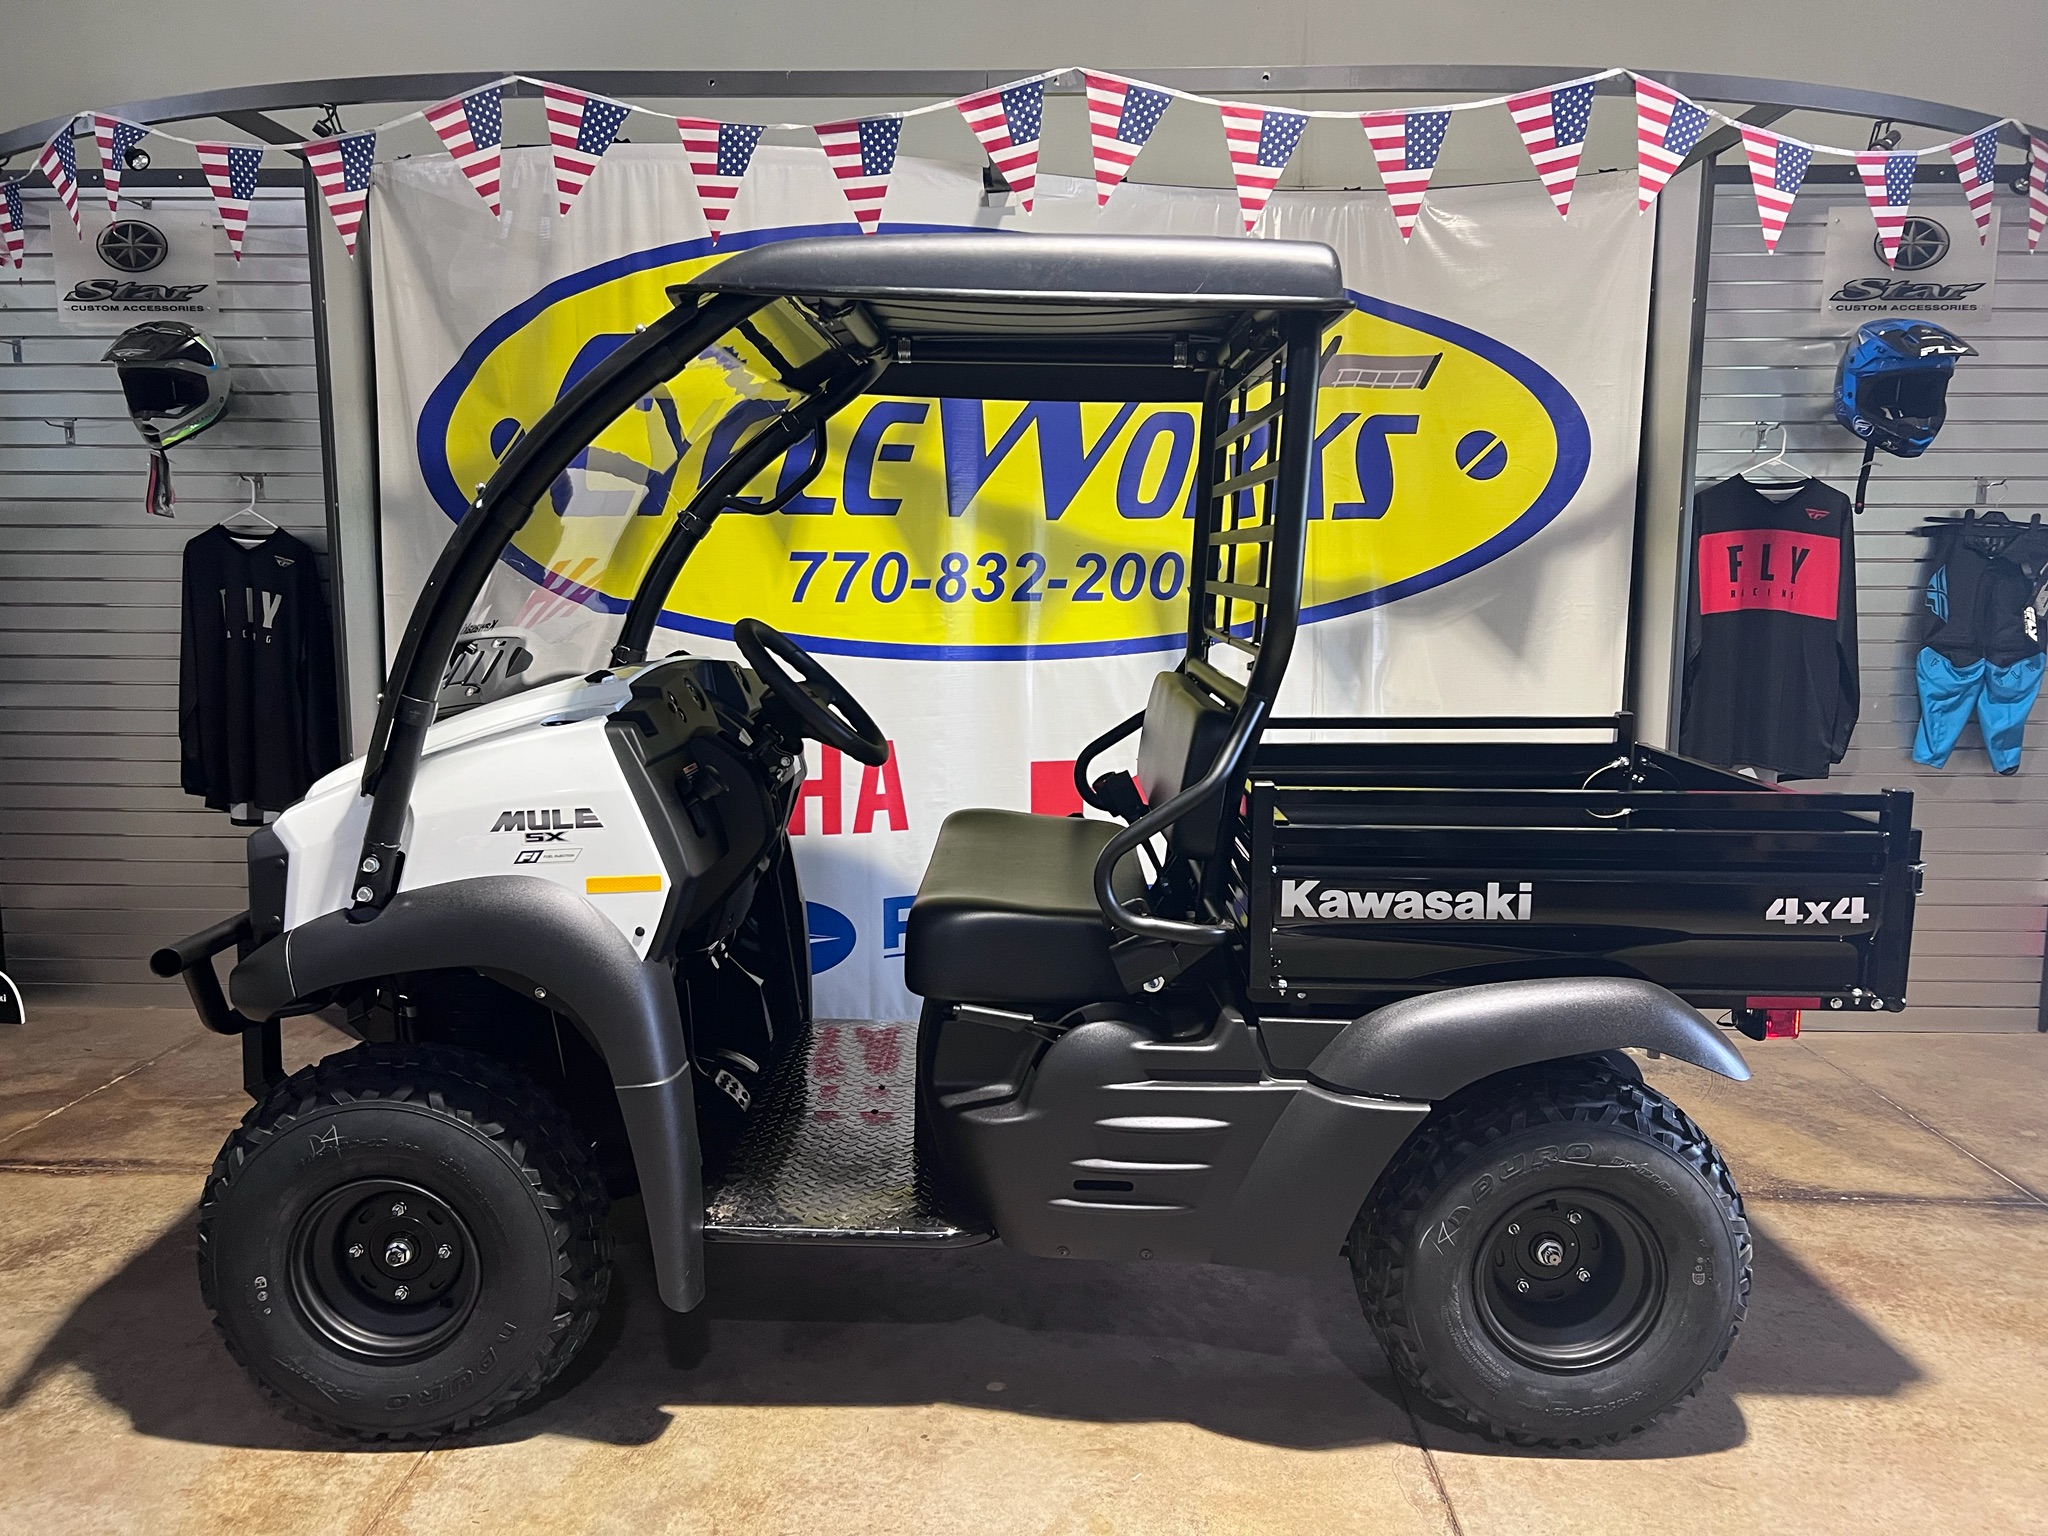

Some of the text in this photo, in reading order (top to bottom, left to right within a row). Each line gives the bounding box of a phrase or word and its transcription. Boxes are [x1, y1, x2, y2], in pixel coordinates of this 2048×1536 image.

[63, 278, 209, 302] Star
[1829, 277, 1987, 301] Star
[1835, 304, 1888, 312] CUSTOM
[1920, 345, 1969, 358] FLY
[1727, 543, 1811, 585] FLY
[788, 550, 1222, 604] 770-832-200
[490, 807, 604, 833] MULE
[525, 832, 570, 843] SX
[516, 852, 541, 863] FI
[1280, 879, 1533, 922] Kawasaki
[1765, 896, 1870, 925] 4x4
[1472, 1142, 1594, 1203] DURO
